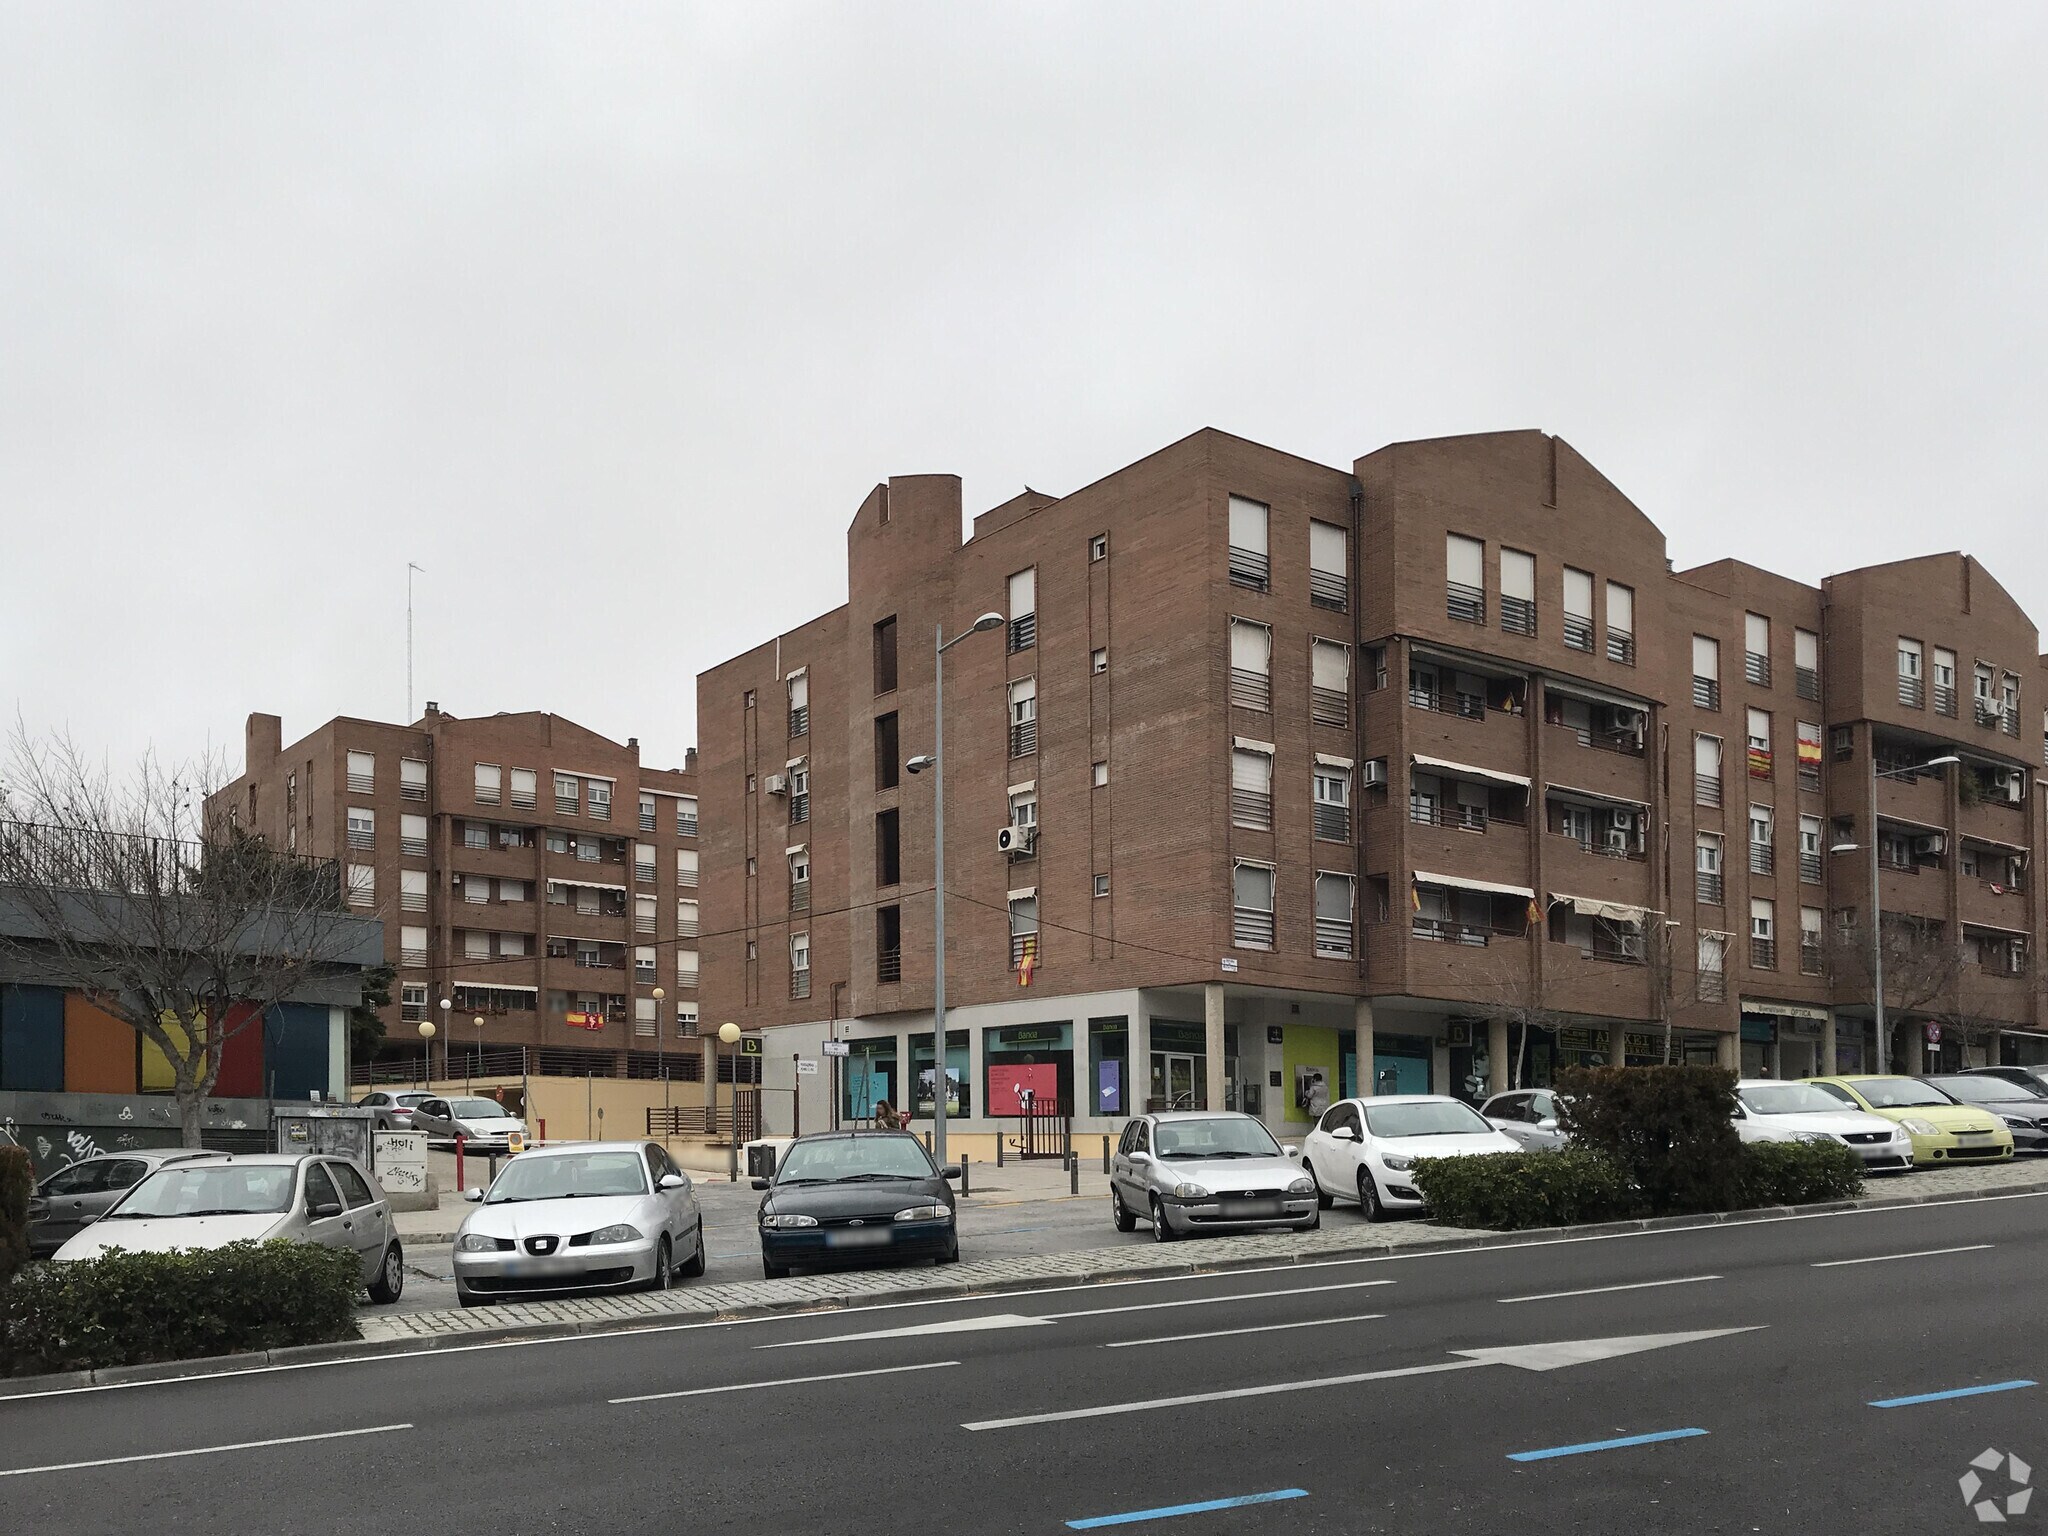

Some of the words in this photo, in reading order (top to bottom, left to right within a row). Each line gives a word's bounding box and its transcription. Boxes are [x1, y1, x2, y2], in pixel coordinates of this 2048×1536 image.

[1018, 1030, 1038, 1040] Bankia
[1454, 1026, 1464, 1041] B
[746, 1039, 757, 1052] B
